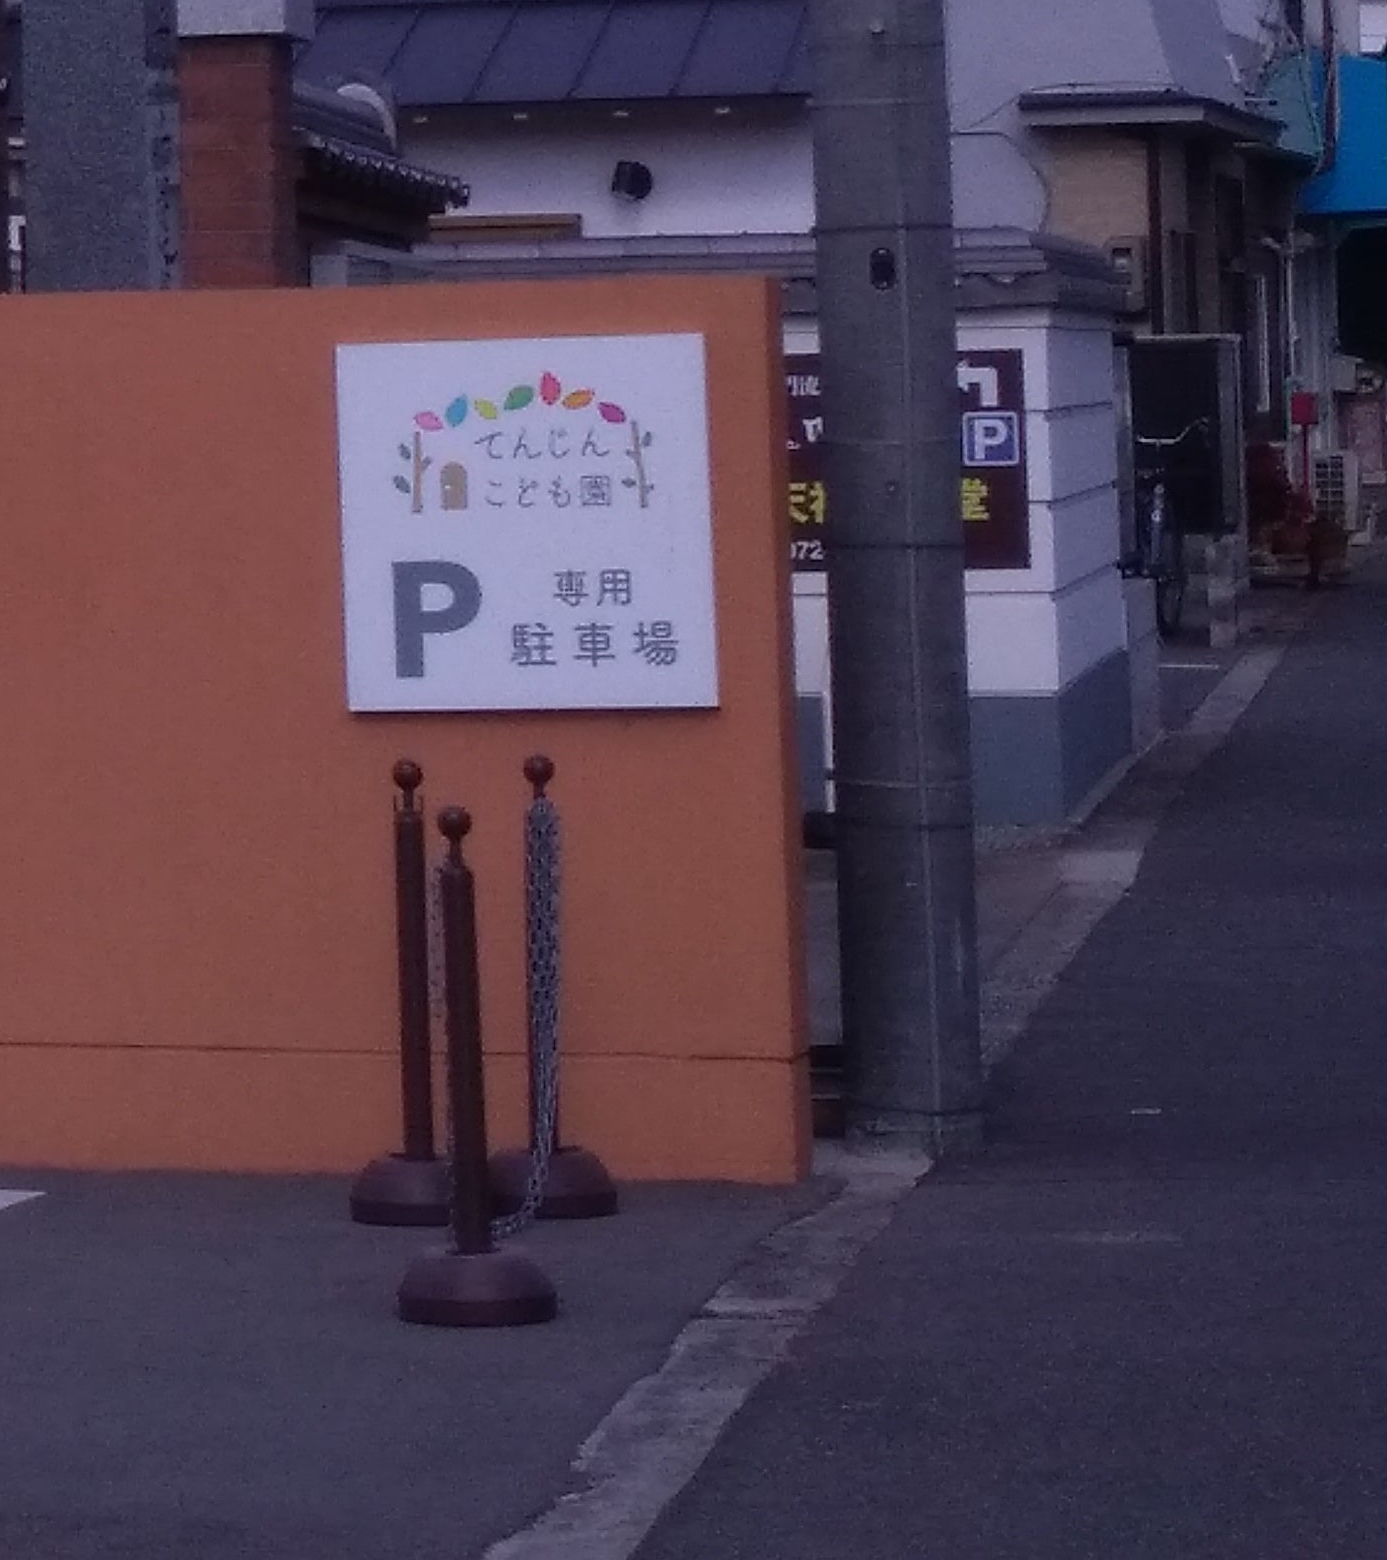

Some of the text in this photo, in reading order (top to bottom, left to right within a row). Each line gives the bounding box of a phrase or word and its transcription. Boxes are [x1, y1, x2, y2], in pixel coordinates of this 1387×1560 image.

[473, 426, 611, 460] てんじん
[974, 418, 1008, 460] P
[483, 474, 612, 508] こども園
[552, 567, 633, 608] 専用
[391, 560, 483, 679] P
[509, 620, 680, 668] 駐車場
